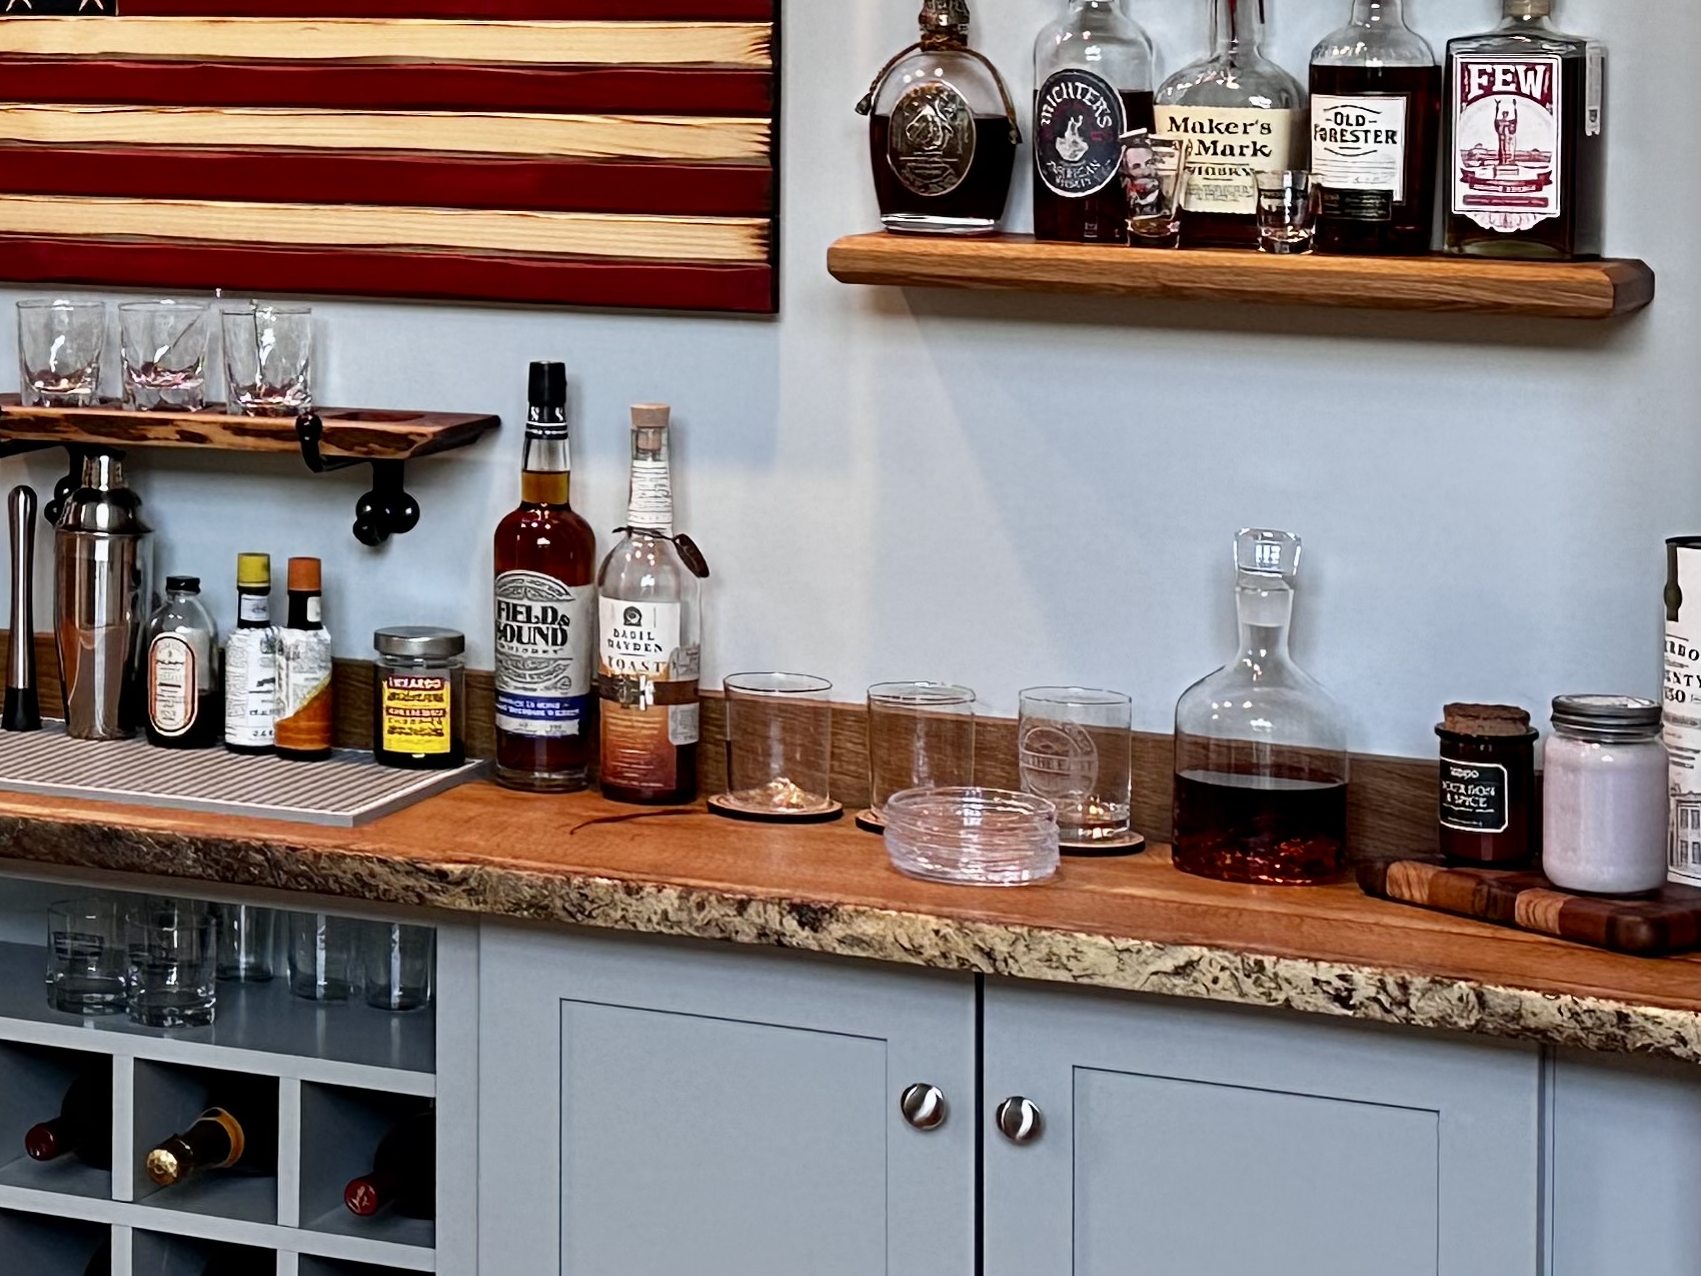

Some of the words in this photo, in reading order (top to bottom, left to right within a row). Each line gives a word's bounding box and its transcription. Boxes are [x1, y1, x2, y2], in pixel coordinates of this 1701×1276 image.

[1468, 64, 1547, 100] FEW
[1166, 115, 1273, 136] Maker's
[1314, 123, 1398, 145] FORESTER
[1195, 140, 1273, 158] Mark
[497, 599, 559, 625] FIELD
[607, 655, 667, 673] TOAST
